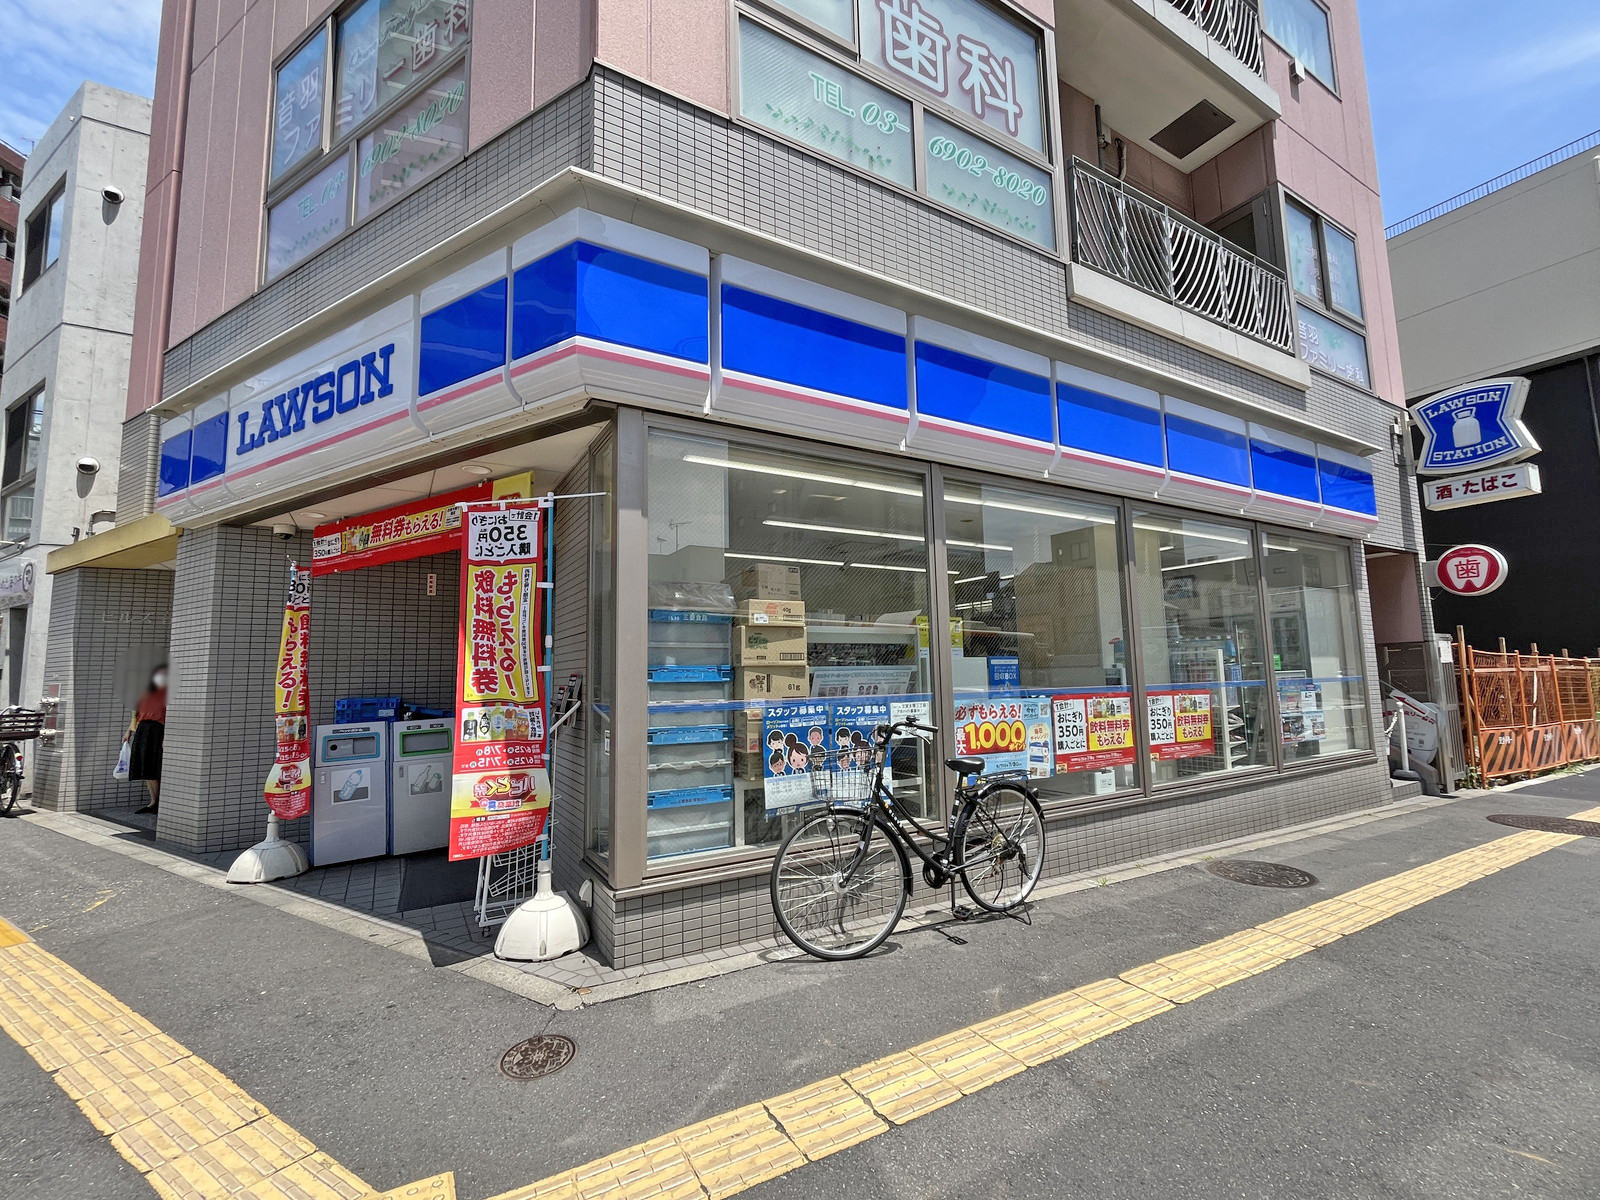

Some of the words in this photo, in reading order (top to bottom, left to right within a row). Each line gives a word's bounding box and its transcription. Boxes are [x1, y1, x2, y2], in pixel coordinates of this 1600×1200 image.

[874, 0, 1024, 136] 歯科
[236, 342, 395, 456] LAWSON
[1426, 391, 1502, 419] LAWSON
[1432, 436, 1509, 462] STATION
[1435, 473, 1518, 500] 酒・たばこ
[1454, 559, 1481, 579] 歯
[767, 705, 824, 718] スタッフ募集中
[836, 705, 887, 716] スタッフ募集中
[954, 704, 1022, 721] 必ずもらえる!
[1057, 711, 1083, 723] おにぎり
[1150, 706, 1172, 717] おにぎり
[1089, 719, 1130, 734] 飲料無料券
[1176, 713, 1209, 727] 飲料無料券
[956, 728, 967, 754] 最大
[964, 720, 1027, 750] 1,000
[1057, 740, 1086, 751] 購入ごとに
